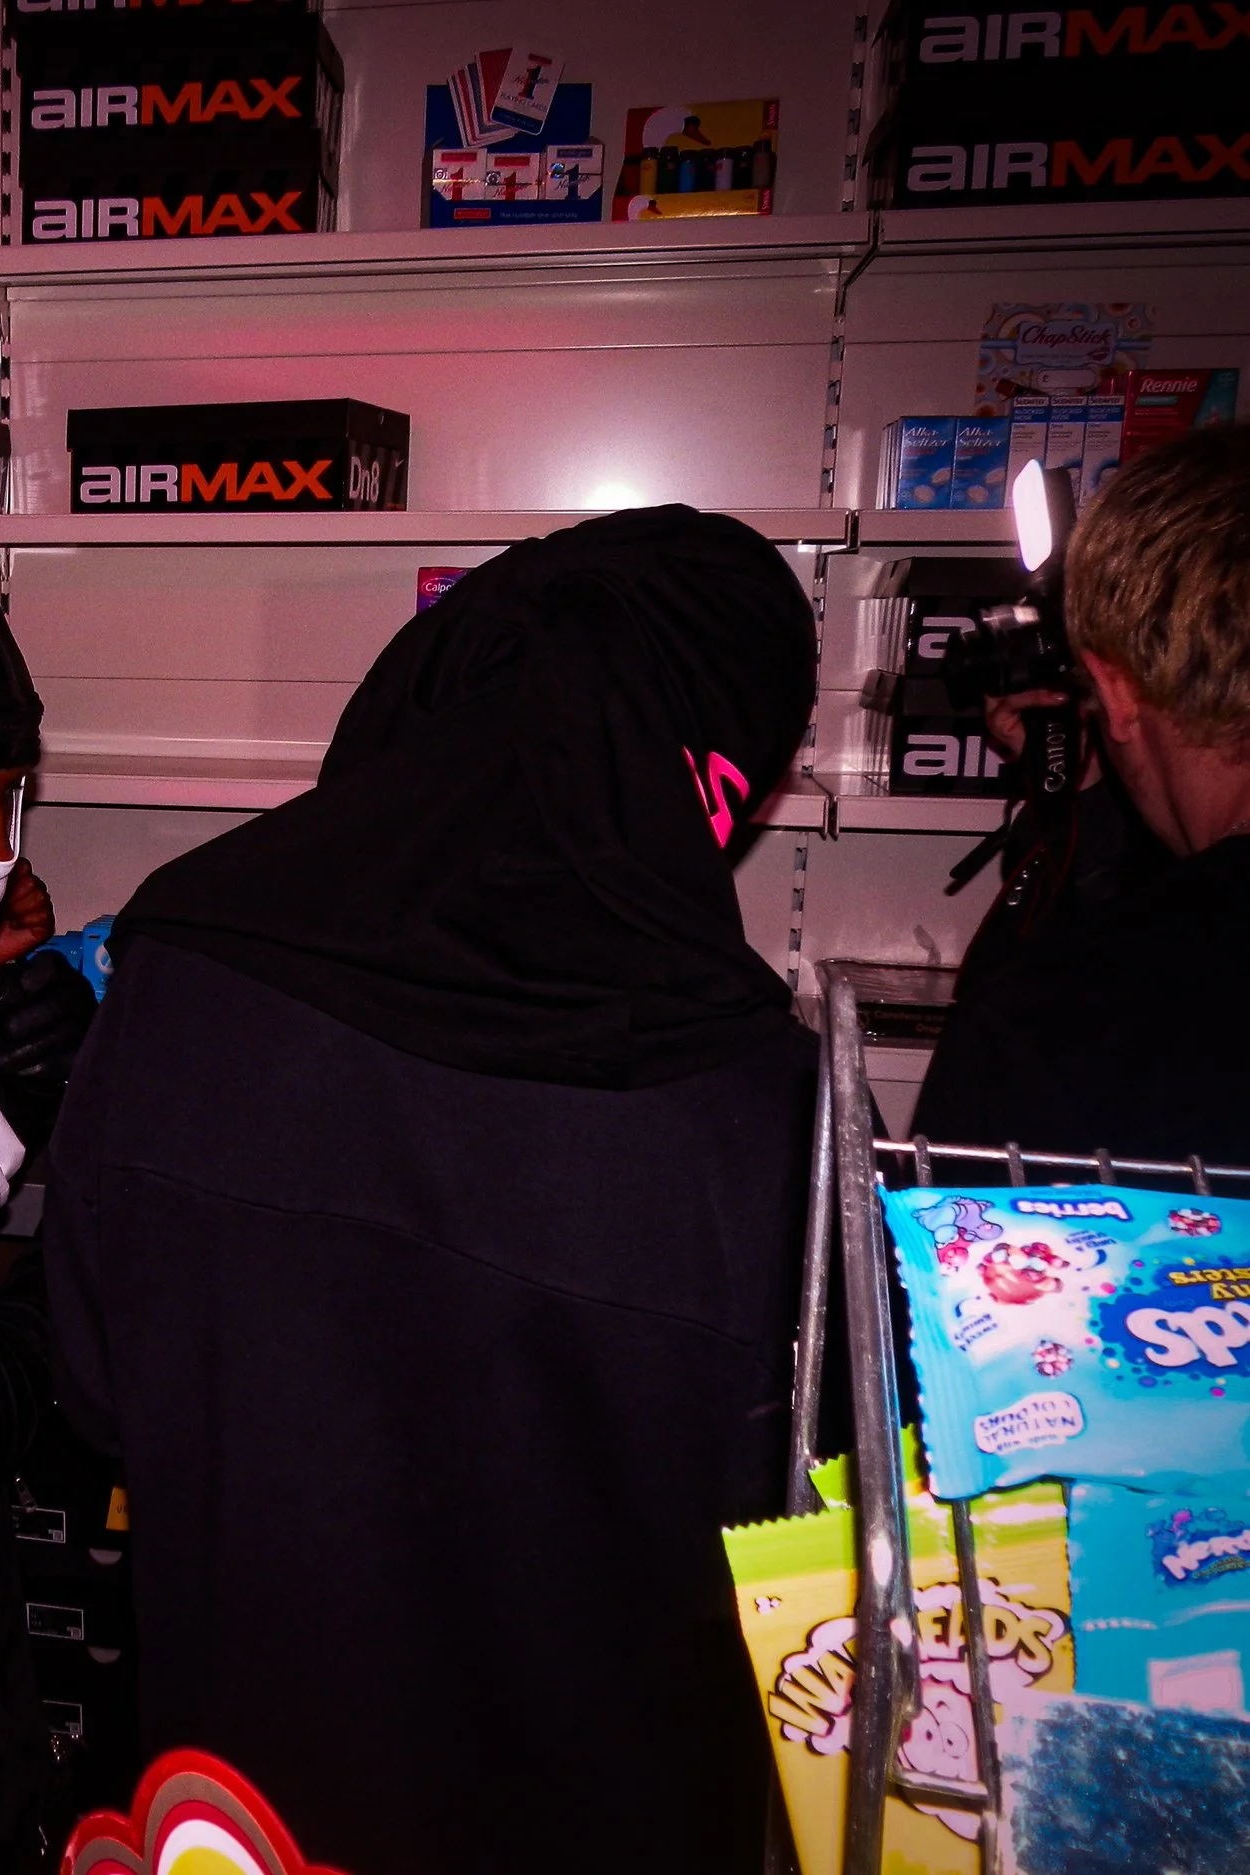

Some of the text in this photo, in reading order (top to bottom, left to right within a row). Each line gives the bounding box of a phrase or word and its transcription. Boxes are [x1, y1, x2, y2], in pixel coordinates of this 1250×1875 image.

[565, 164, 580, 200] 1
[1140, 377, 1198, 394] Rennie
[350, 456, 381, 503] Dn8
[425, 582, 452, 594] Calpo
[1043, 721, 1068, 793] Canon
[1016, 1199, 1131, 1220] berries
[982, 1415, 1076, 1445] NATURAL
